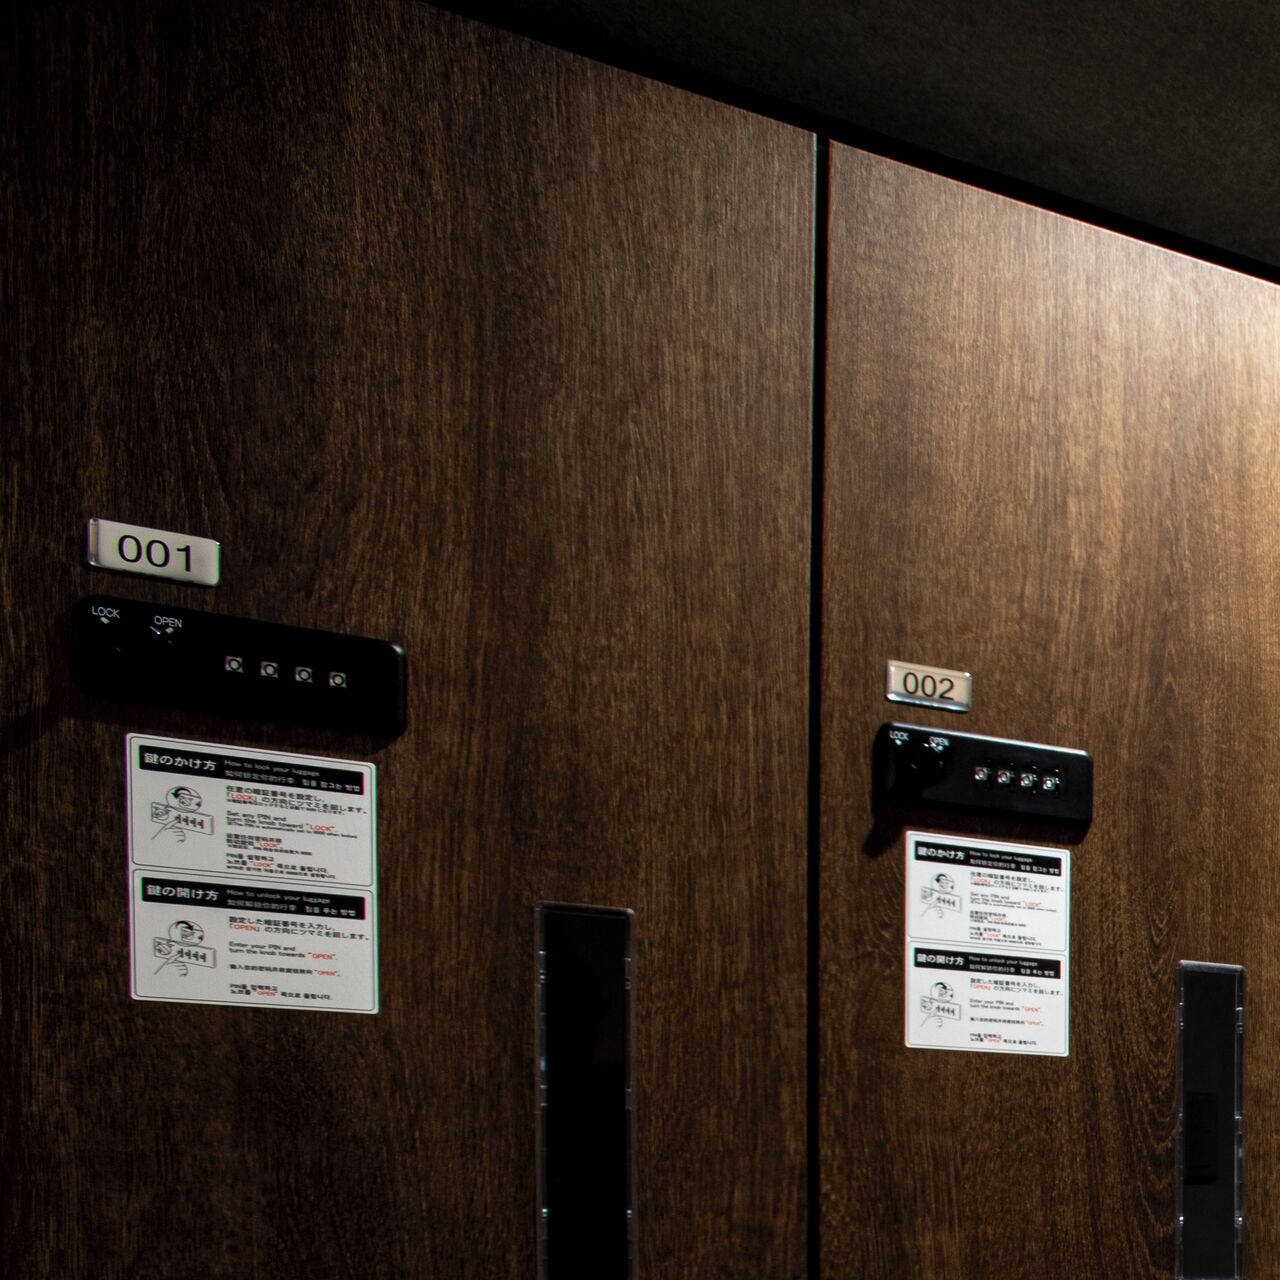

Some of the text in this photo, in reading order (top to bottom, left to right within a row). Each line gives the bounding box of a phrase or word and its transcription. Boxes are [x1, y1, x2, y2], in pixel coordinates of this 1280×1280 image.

[118, 534, 192, 572] 001
[92, 606, 120, 619] LOCK
[154, 616, 182, 628] OPEN
[903, 672, 954, 701] 002
[890, 730, 908, 741] LOCK
[929, 737, 949, 747] OPEN
[144, 752, 216, 771] 鍵のかけ方
[146, 884, 219, 901] 鍵の開け方
